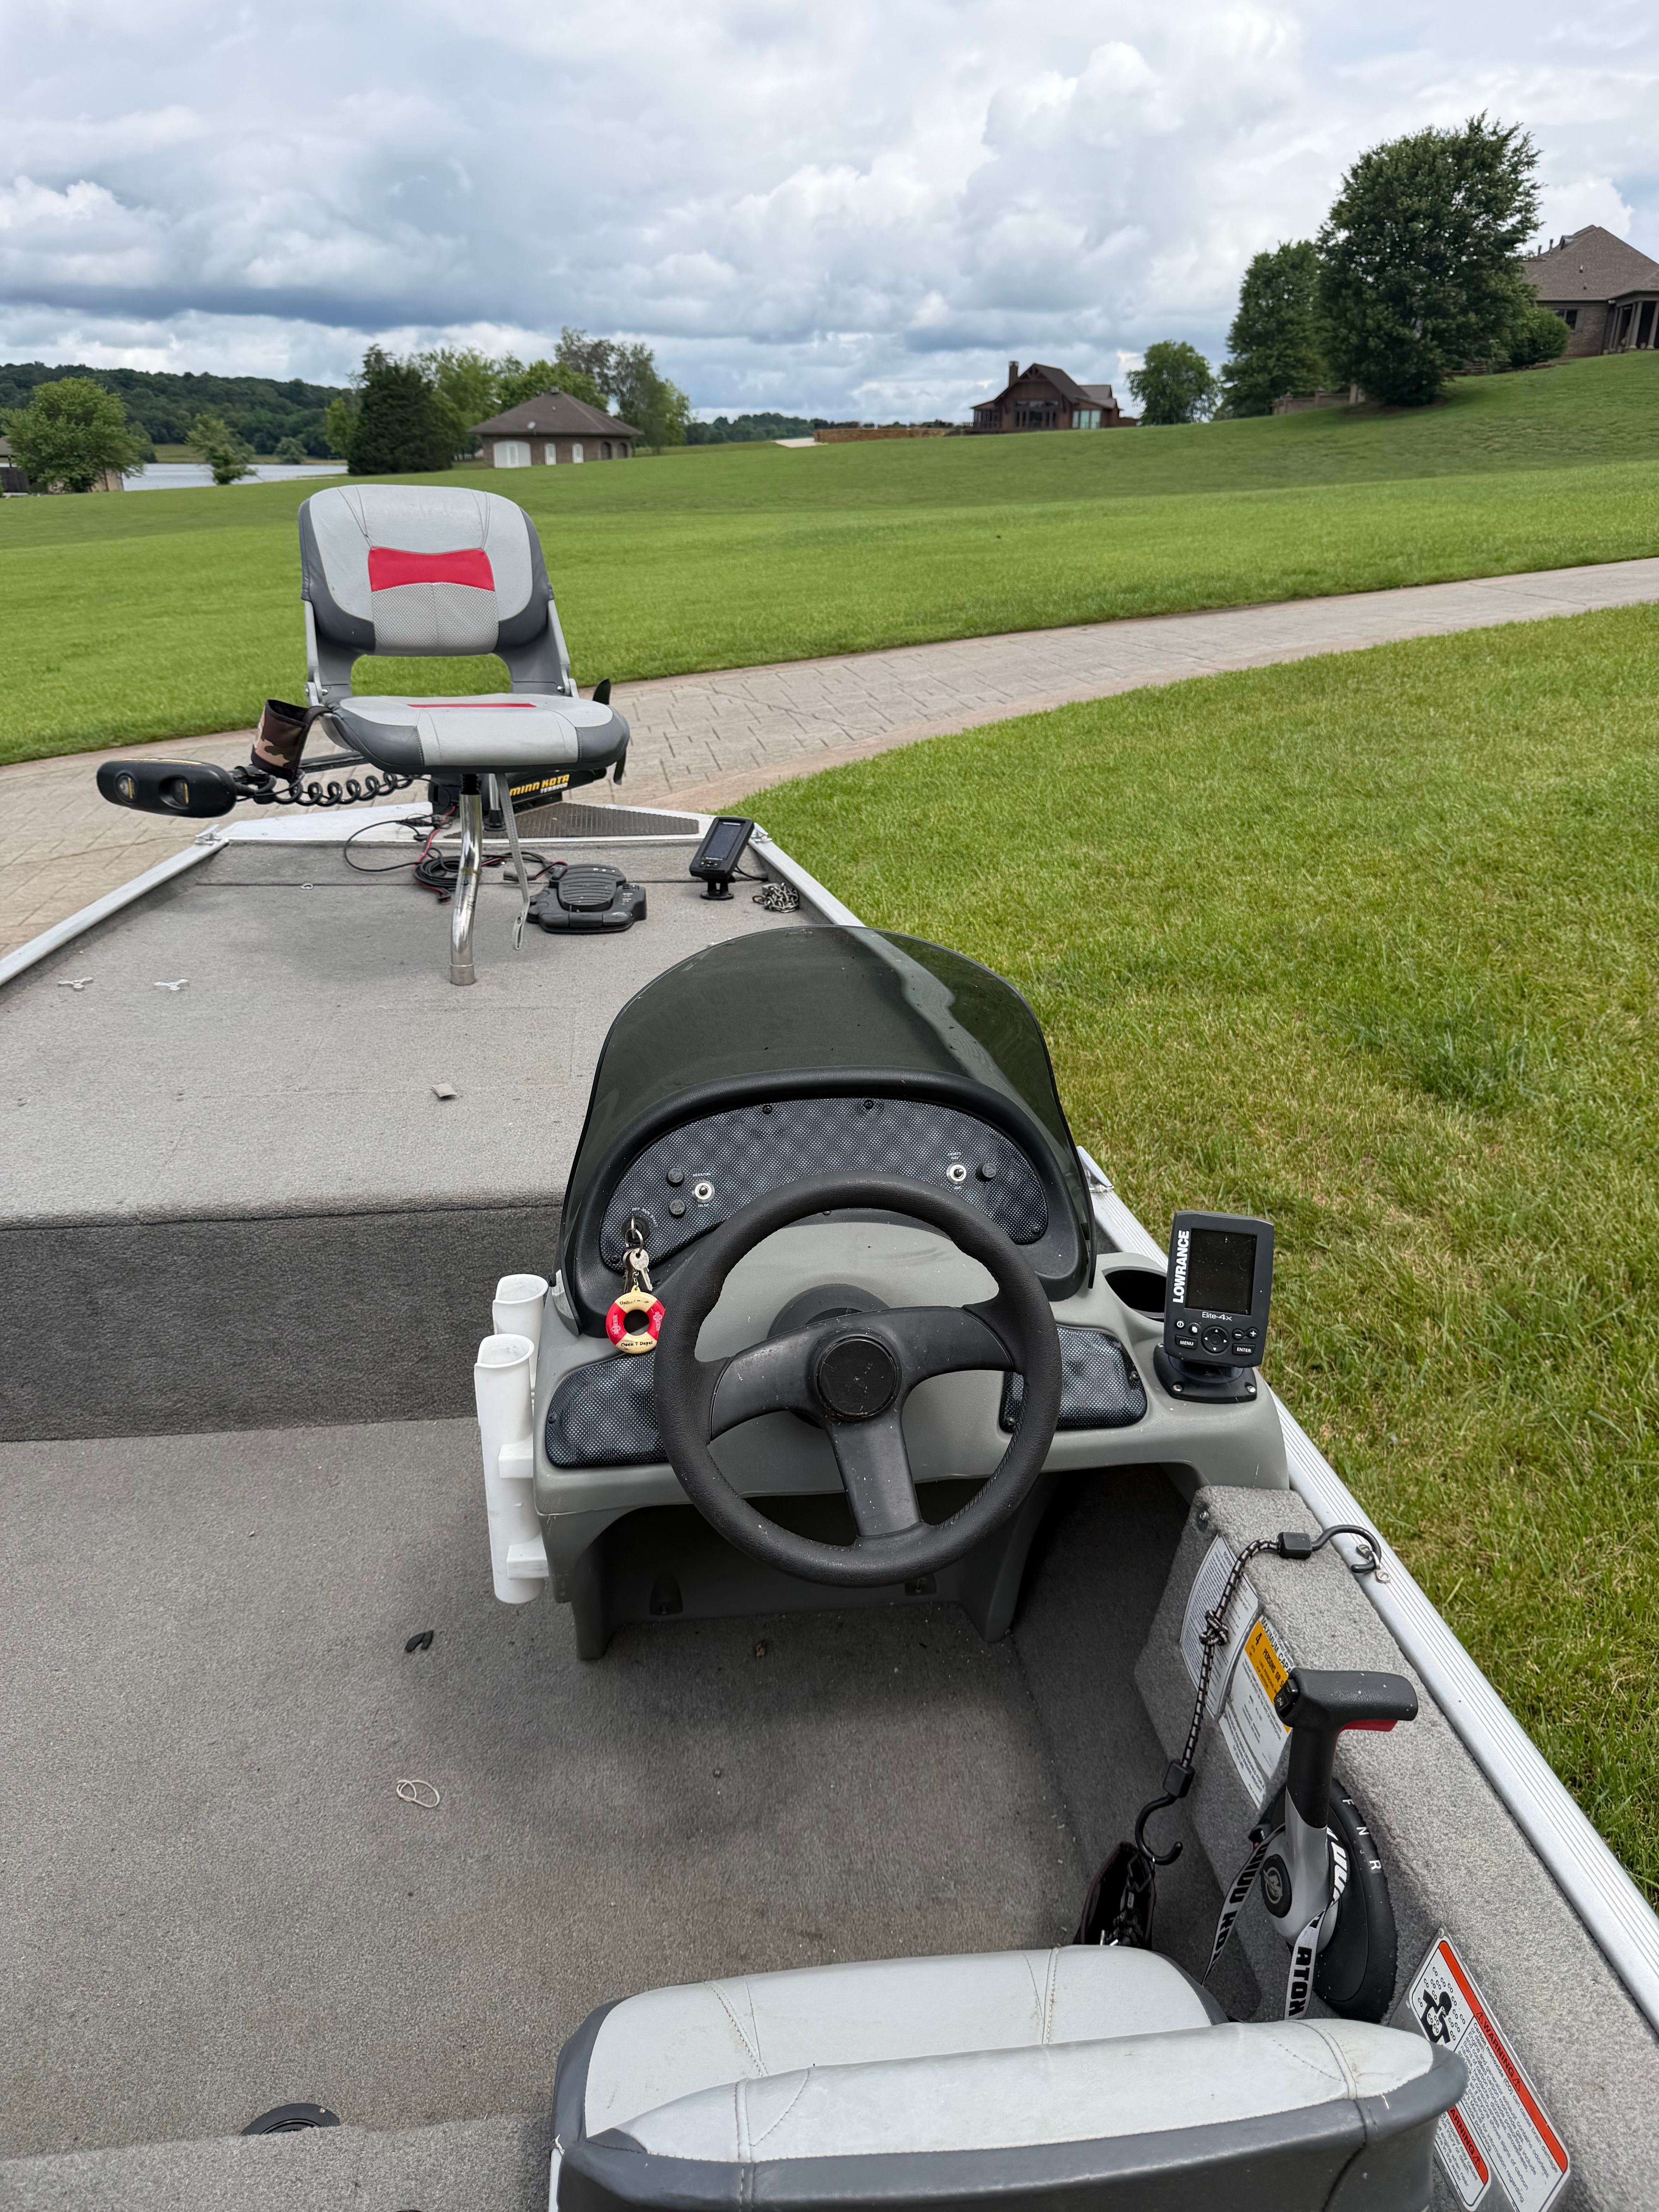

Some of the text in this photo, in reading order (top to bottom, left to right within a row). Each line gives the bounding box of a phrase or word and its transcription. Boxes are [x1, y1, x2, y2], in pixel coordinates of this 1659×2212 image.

[509, 774, 570, 797] MINN KOTA
[1173, 1230, 1189, 1303] LOWRANCE
[1256, 1633, 1262, 1645] 4
[1261, 1616, 1279, 1654] MAXIMUM
[1357, 1826, 1370, 1836] N
[1369, 1860, 1382, 1870] R
[1432, 1966, 1437, 1976] CO
[1424, 1978, 1429, 1988] CO
[1430, 1979, 1436, 1989] CO
[1436, 1980, 1441, 1990] CO
[1440, 1977, 1446, 1987] CO
[1448, 1983, 1453, 1993] CO
[1432, 1990, 1437, 2000] CO
[1417, 1997, 1423, 2007] CO
[1451, 1996, 1456, 2006] CO
[1428, 2013, 1433, 2023] CO
[1453, 2009, 1458, 2019] CO
[1460, 2014, 1465, 2024] CO
[1434, 2015, 1439, 2025] CO
[1448, 2017, 1453, 2028] CO
[1434, 2023, 1438, 2033] CO
[1455, 2022, 1460, 2032] CO
[1450, 2030, 1455, 2040] CO
[1484, 2021, 1514, 2078] WARNING
[1472, 2049, 1487, 2076] colorless
[1487, 2076, 1499, 2098] carbon
[1499, 2098, 1516, 2130] monoxide
[1474, 2023, 1486, 2046] Carbon
[1486, 2046, 1503, 2078] monoxide
[1503, 2078, 1513, 2095] (CO)
[1520, 2108, 1532, 2127] cause
[1531, 2127, 1541, 2145] brain
[1542, 2146, 1558, 2173] damage
[1462, 2094, 1475, 2120] onoxide
[1463, 2041, 1472, 2058] Signs
[1476, 2066, 1488, 2087] carbon
[1488, 2088, 1504, 2118] monoxide
[1504, 2119, 1523, 2151] poisoning
[1522, 2151, 1536, 2175] include
[1468, 2031, 1480, 2053] Engine
[1486, 2066, 1503, 2095] generator
[1503, 2096, 1517, 2121] exhaust
[1517, 2121, 1532, 2149] contains
[1532, 2149, 1549, 2178] odorless
[1449, 2106, 1475, 2155] ARNING
[1446, 2128, 1456, 2146] injury
[1477, 2095, 1490, 2119] anyone
[1489, 2119, 1501, 2140] shows
[1501, 2140, 1511, 2158] signs
[1515, 2167, 1528, 2190] carbon
[1446, 2118, 1460, 2145] propeller
[1467, 2161, 1477, 2181] cause
[1470, 2100, 1483, 2124] Manual
[1487, 2133, 1506, 2169] information
[1506, 2170, 1524, 2203] regarding
[1441, 2133, 1452, 2154] engine
[1452, 2154, 1460, 2172] when
[1460, 2172, 1468, 2186] near
